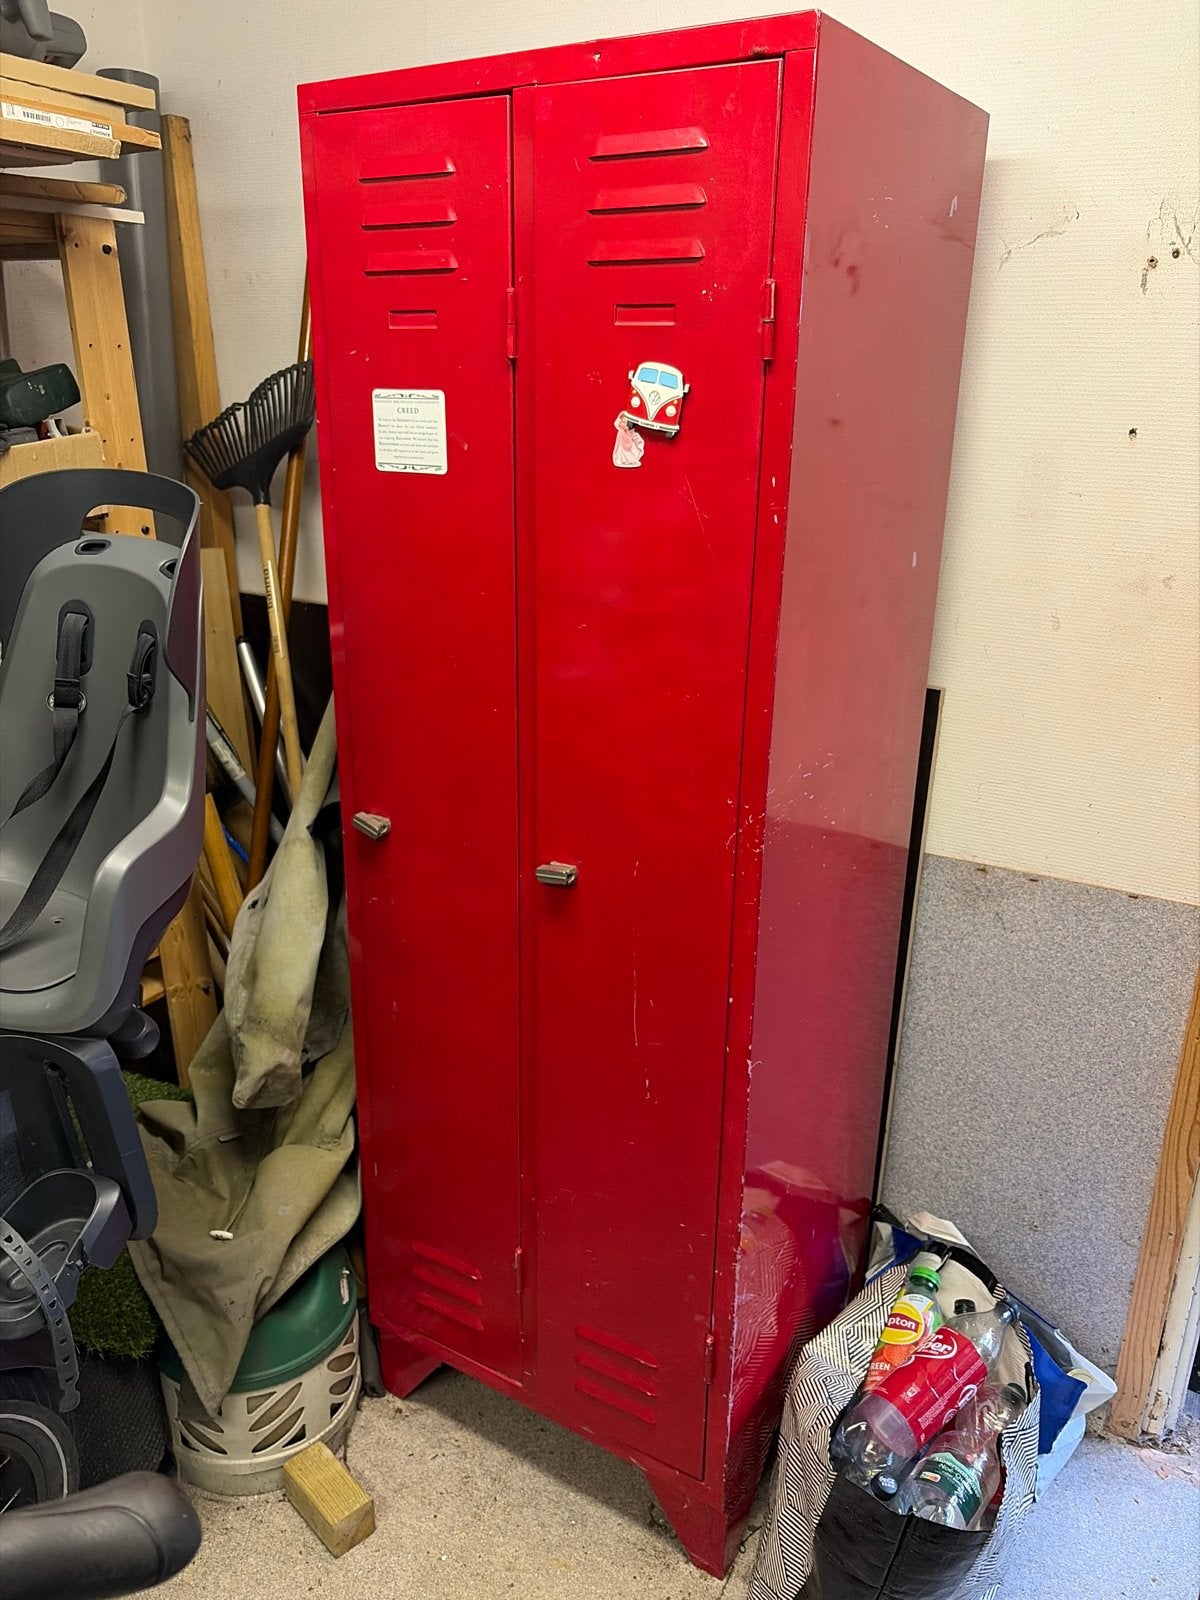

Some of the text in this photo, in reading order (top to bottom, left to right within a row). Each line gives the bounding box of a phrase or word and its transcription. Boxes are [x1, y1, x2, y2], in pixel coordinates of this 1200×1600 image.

[396, 407, 420, 415] CREED
[887, 1316, 916, 1330] pton
[870, 1362, 891, 1371] REEN
